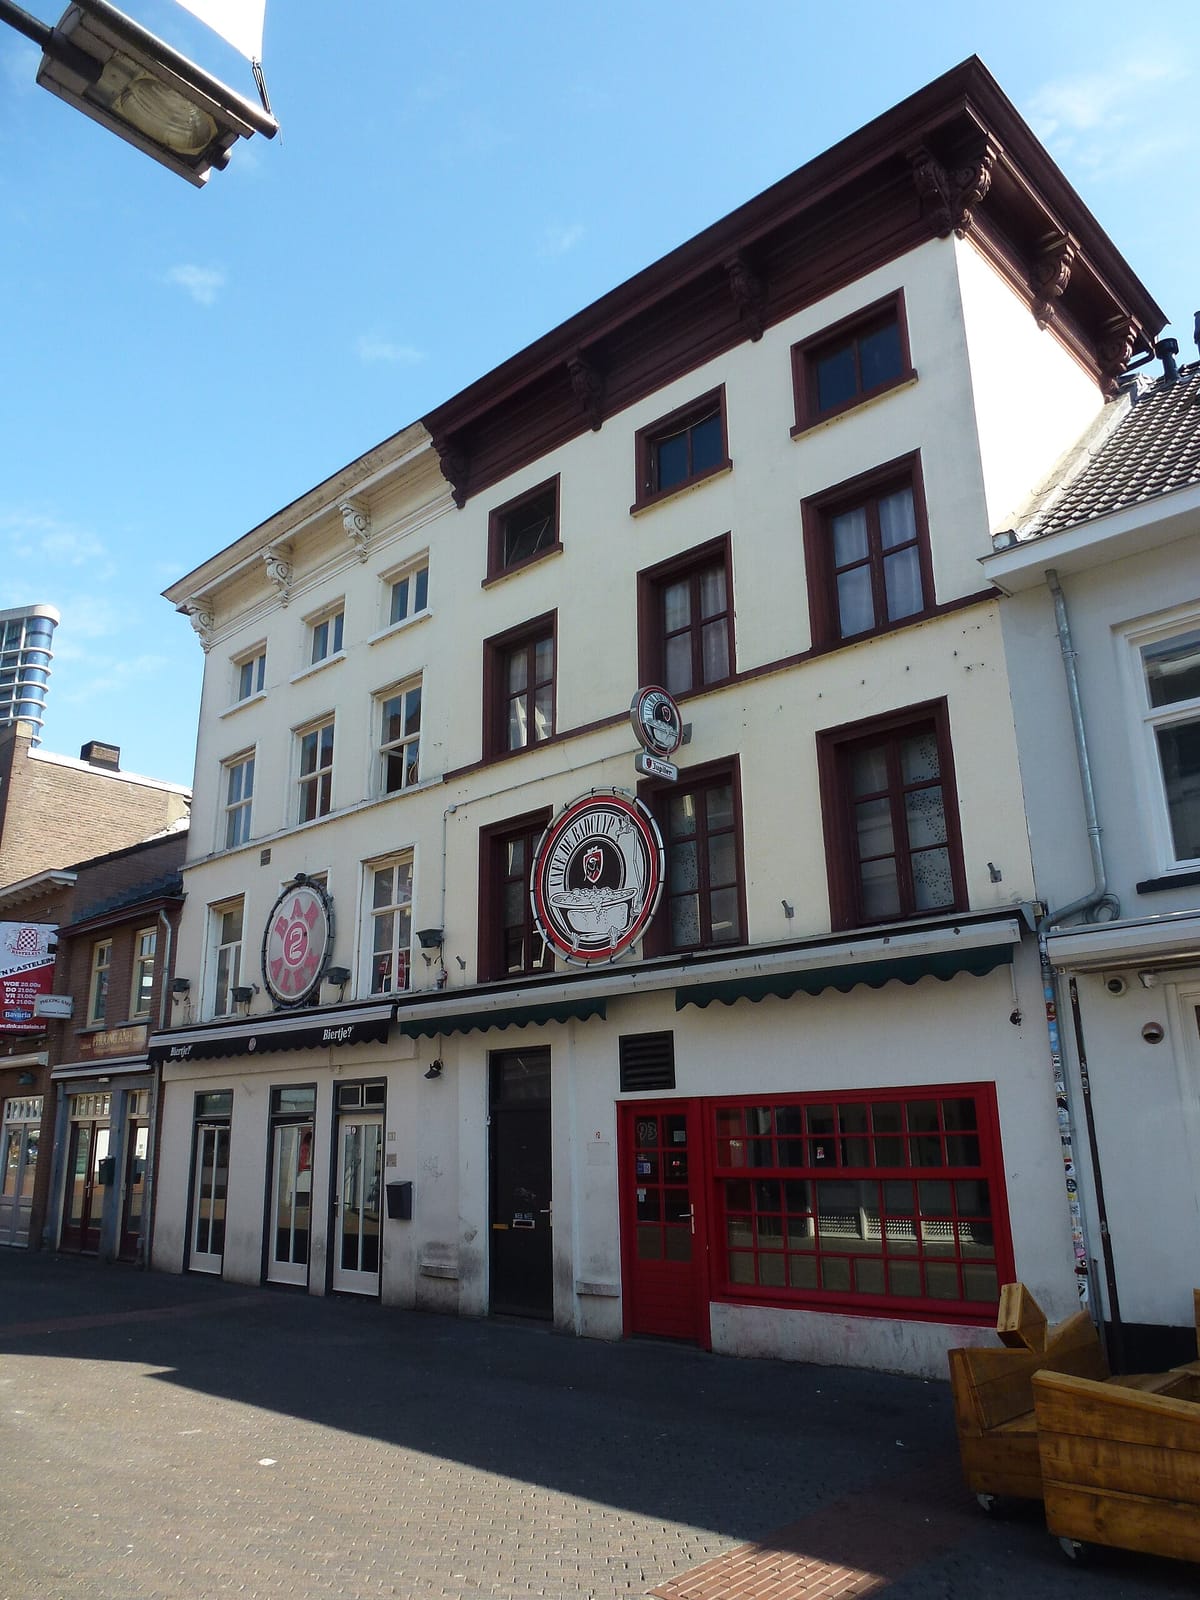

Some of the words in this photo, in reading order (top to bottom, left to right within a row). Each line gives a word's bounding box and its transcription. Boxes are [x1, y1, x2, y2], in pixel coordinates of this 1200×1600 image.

[652, 763, 673, 775] Jupiler
[559, 835, 575, 856] DE
[289, 927, 303, 960] 2
[9, 956, 55, 973] KASTELEIN
[322, 1026, 353, 1042] Biertje?
[637, 1121, 657, 1143] 93
